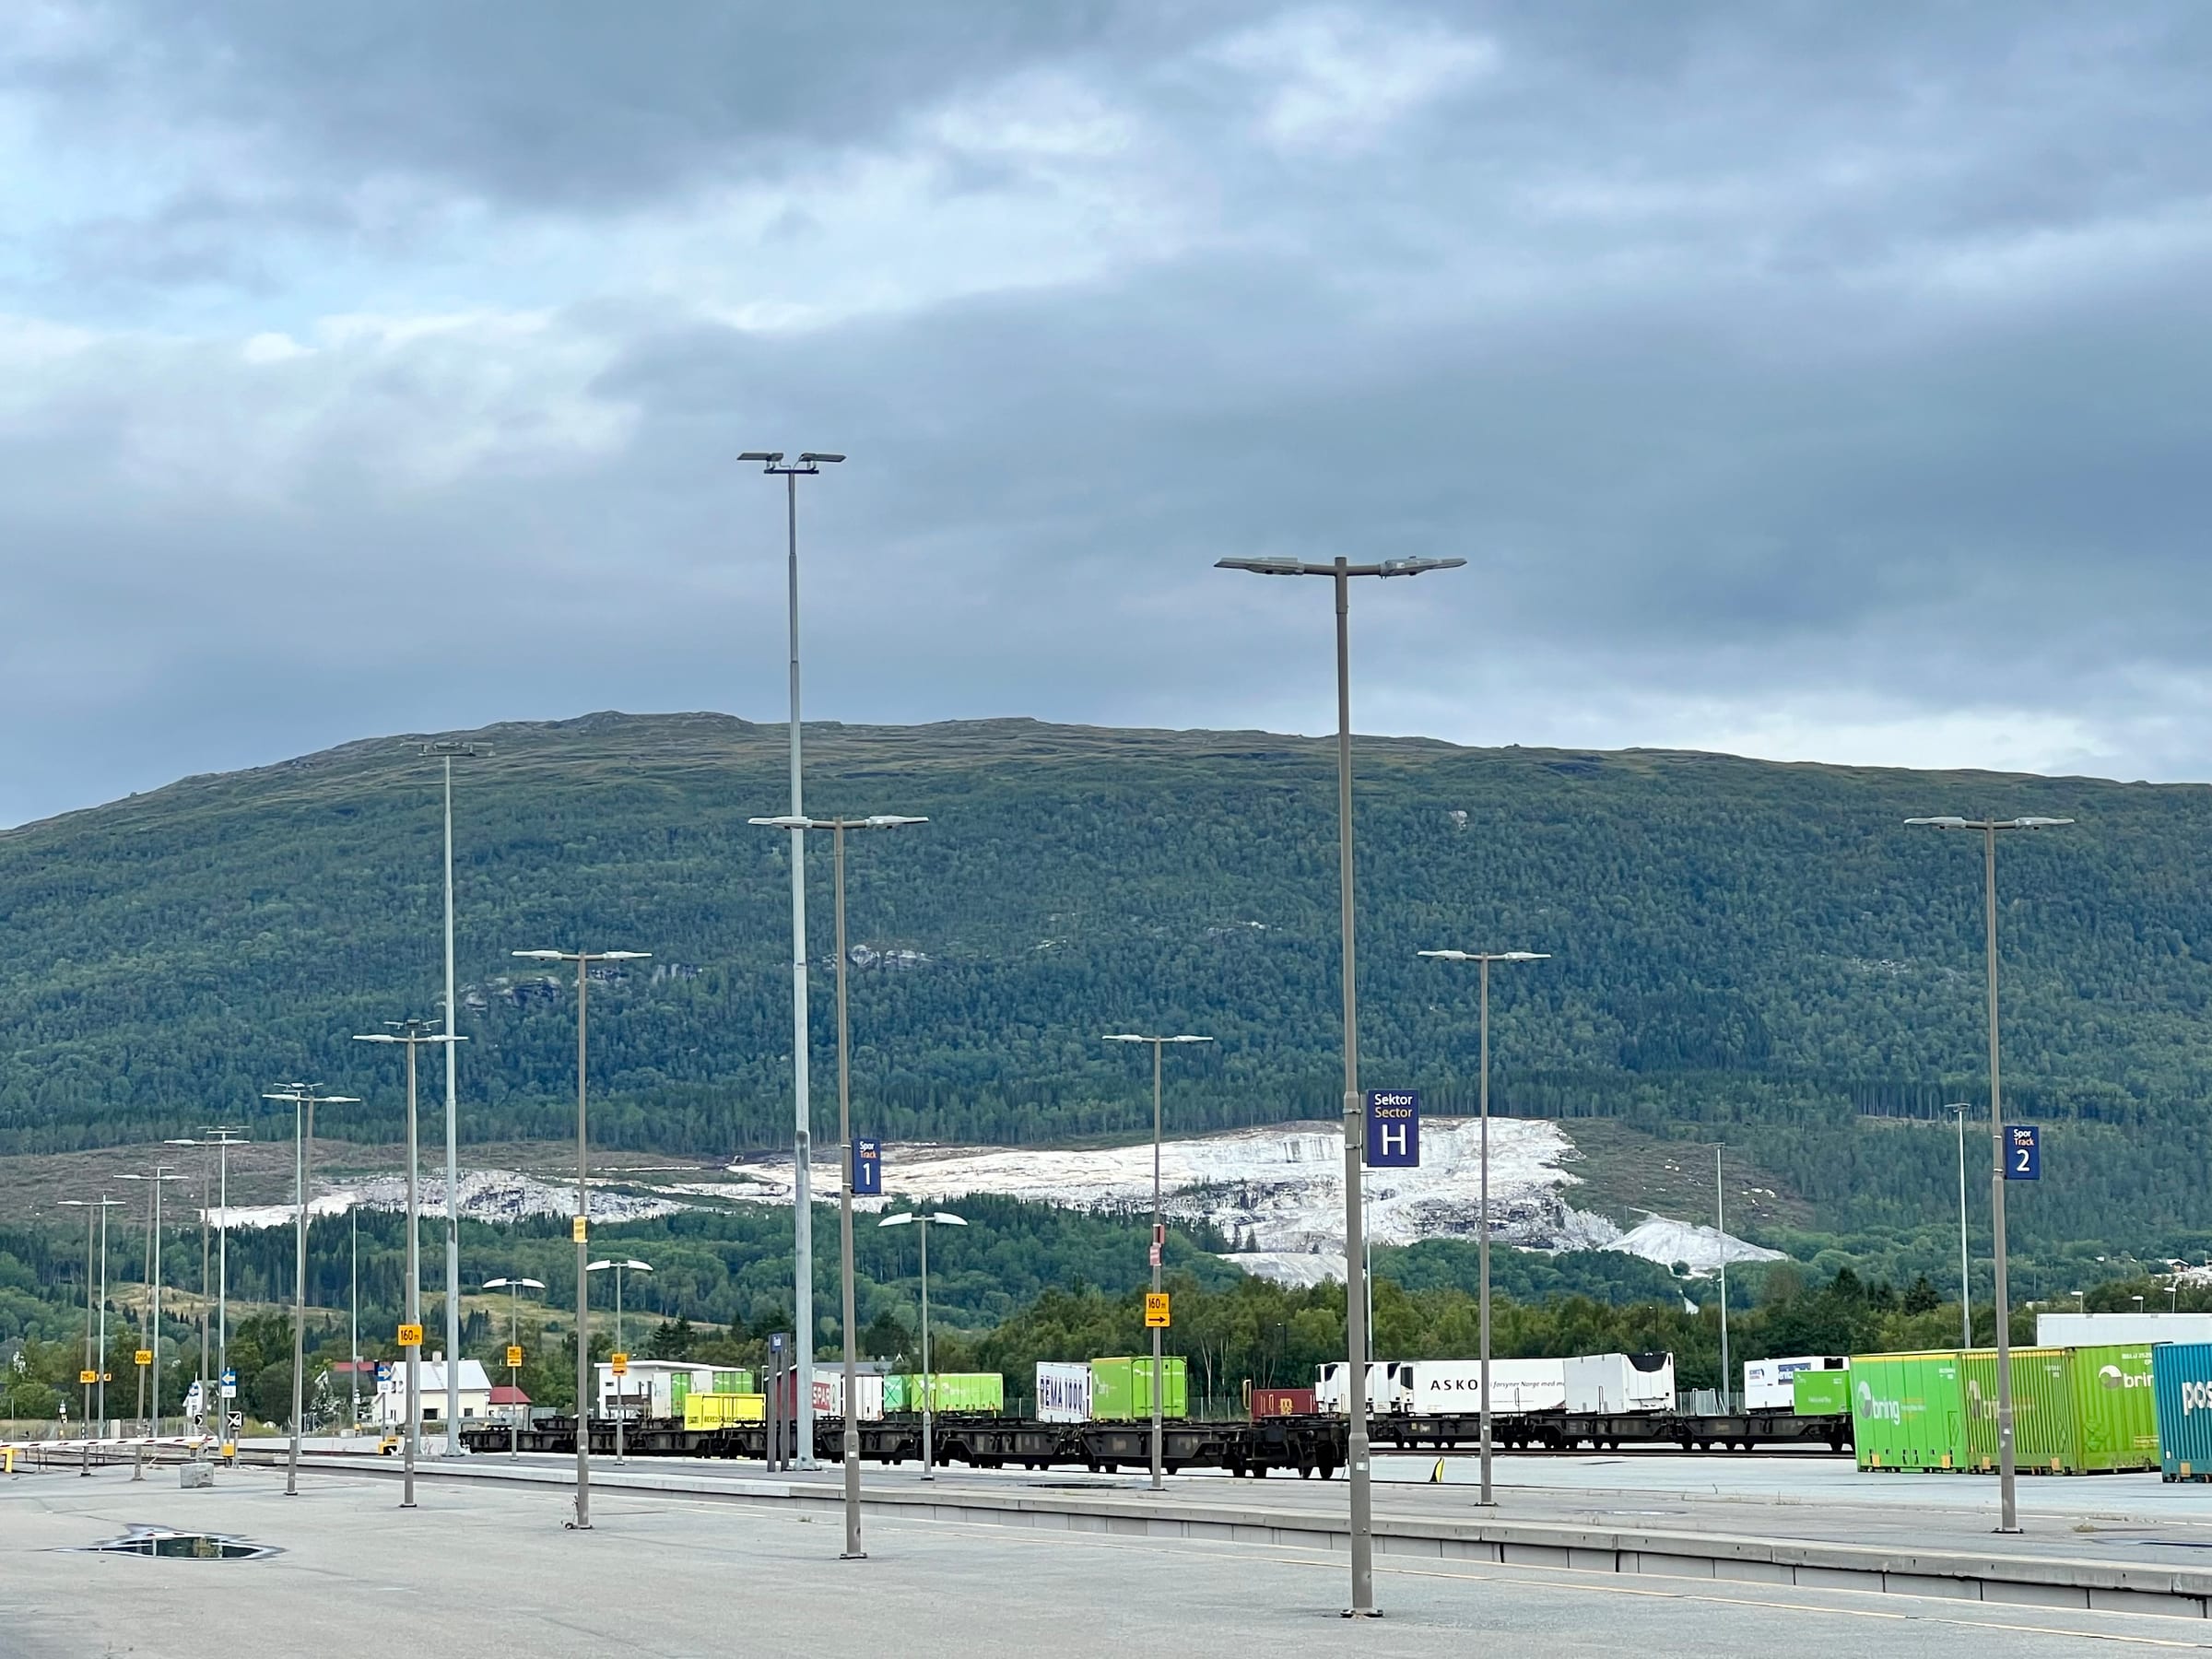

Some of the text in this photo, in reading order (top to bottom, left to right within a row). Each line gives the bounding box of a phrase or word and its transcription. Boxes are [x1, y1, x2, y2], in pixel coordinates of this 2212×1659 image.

[1374, 1093, 1413, 1105] Sektor
[1374, 1107, 1412, 1118] Sector
[2013, 1128, 2031, 1138] Spor
[1382, 1124, 1406, 1156] H
[2013, 1137, 2035, 1147] Track
[859, 1141, 875, 1151] Spor
[859, 1150, 877, 1159] Track
[2016, 1148, 2030, 1171] 2
[863, 1162, 871, 1185] 1
[1148, 1298, 1160, 1309] 160
[400, 1330, 414, 1341] 160
[1430, 1379, 1478, 1391] ASKO
[1521, 1381, 1540, 1389] Norge
[813, 1386, 830, 1406] SPAR
[1041, 1376, 1063, 1411] REMA
[1065, 1378, 1083, 1415] 1000
[1872, 1396, 1900, 1426] bring
